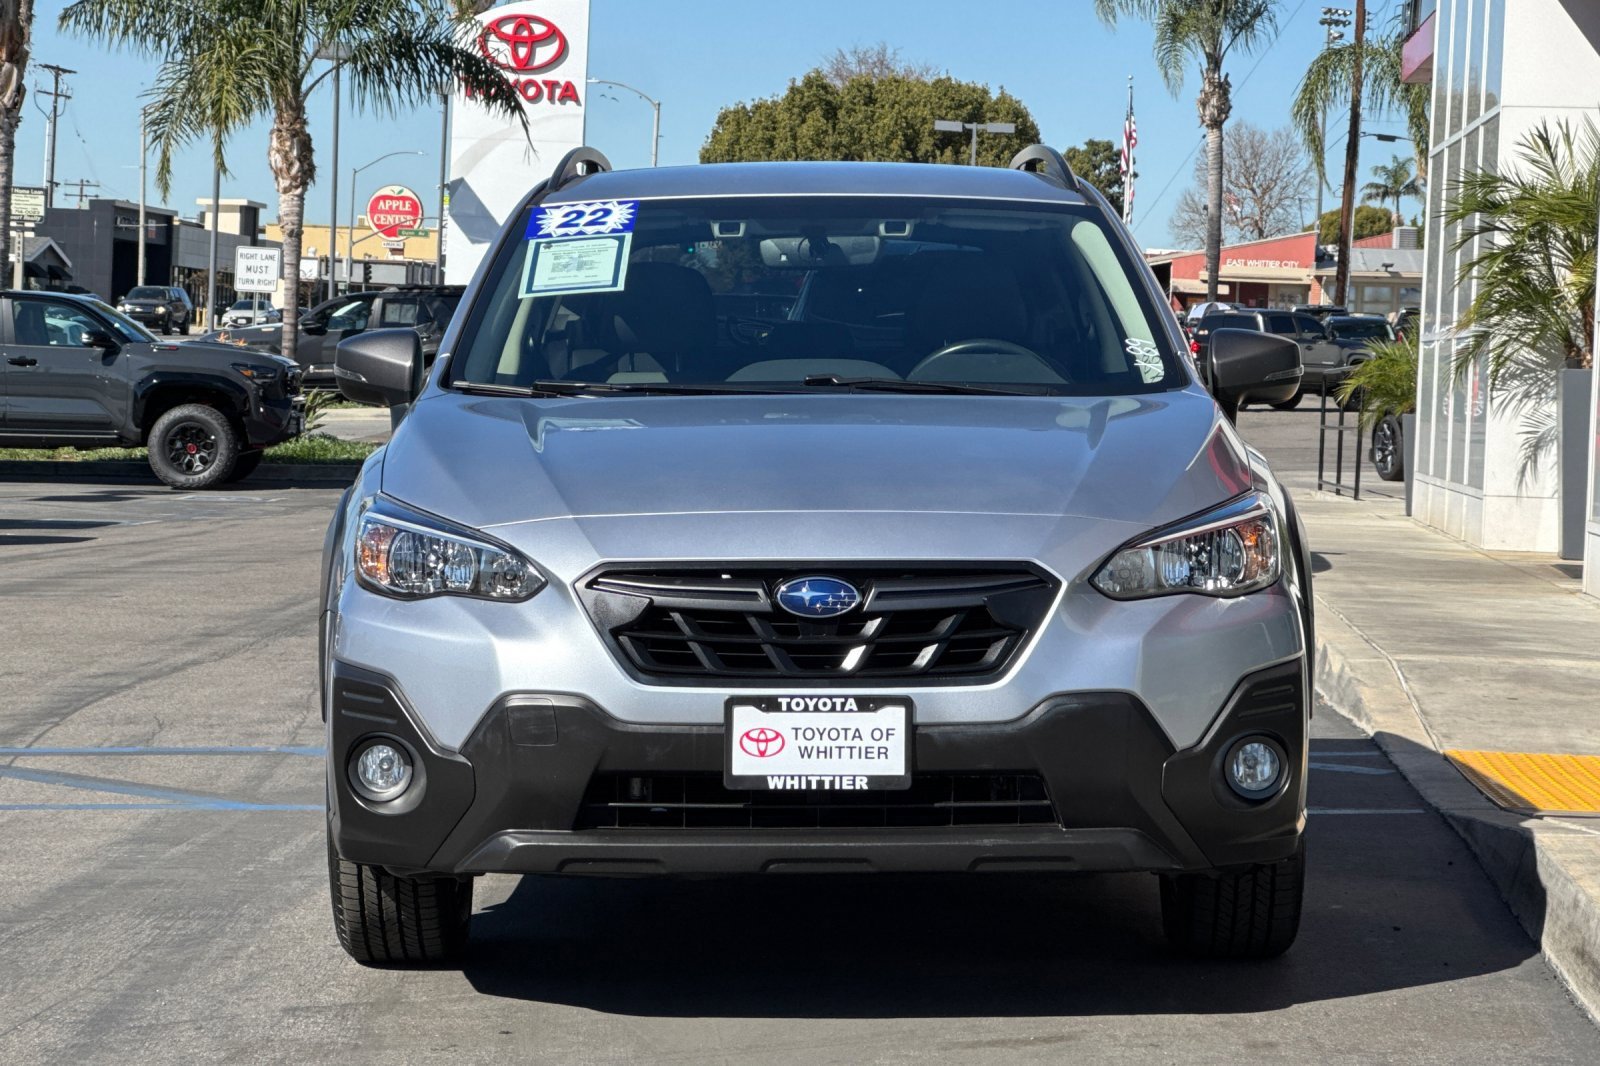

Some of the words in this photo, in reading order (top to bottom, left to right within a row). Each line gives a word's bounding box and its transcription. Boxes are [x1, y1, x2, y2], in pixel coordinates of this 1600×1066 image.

[459, 76, 578, 102] OTA
[377, 199, 412, 211] APPLE
[373, 213, 415, 226] CENTER
[555, 207, 613, 229] 22
[239, 252, 258, 260] RIGHT
[245, 265, 269, 274] MUST
[1226, 258, 1245, 267] EAST
[1246, 259, 1280, 268] WHITTIER
[1281, 260, 1300, 269] CITY
[238, 277, 255, 286] TURN
[256, 279, 276, 287] RIGHT
[777, 698, 859, 712] TOYOTA
[791, 727, 864, 742] TOYOTA
[870, 728, 896, 742] OF
[797, 745, 889, 760] WHITTIER
[766, 775, 869, 790] WHITTIER
